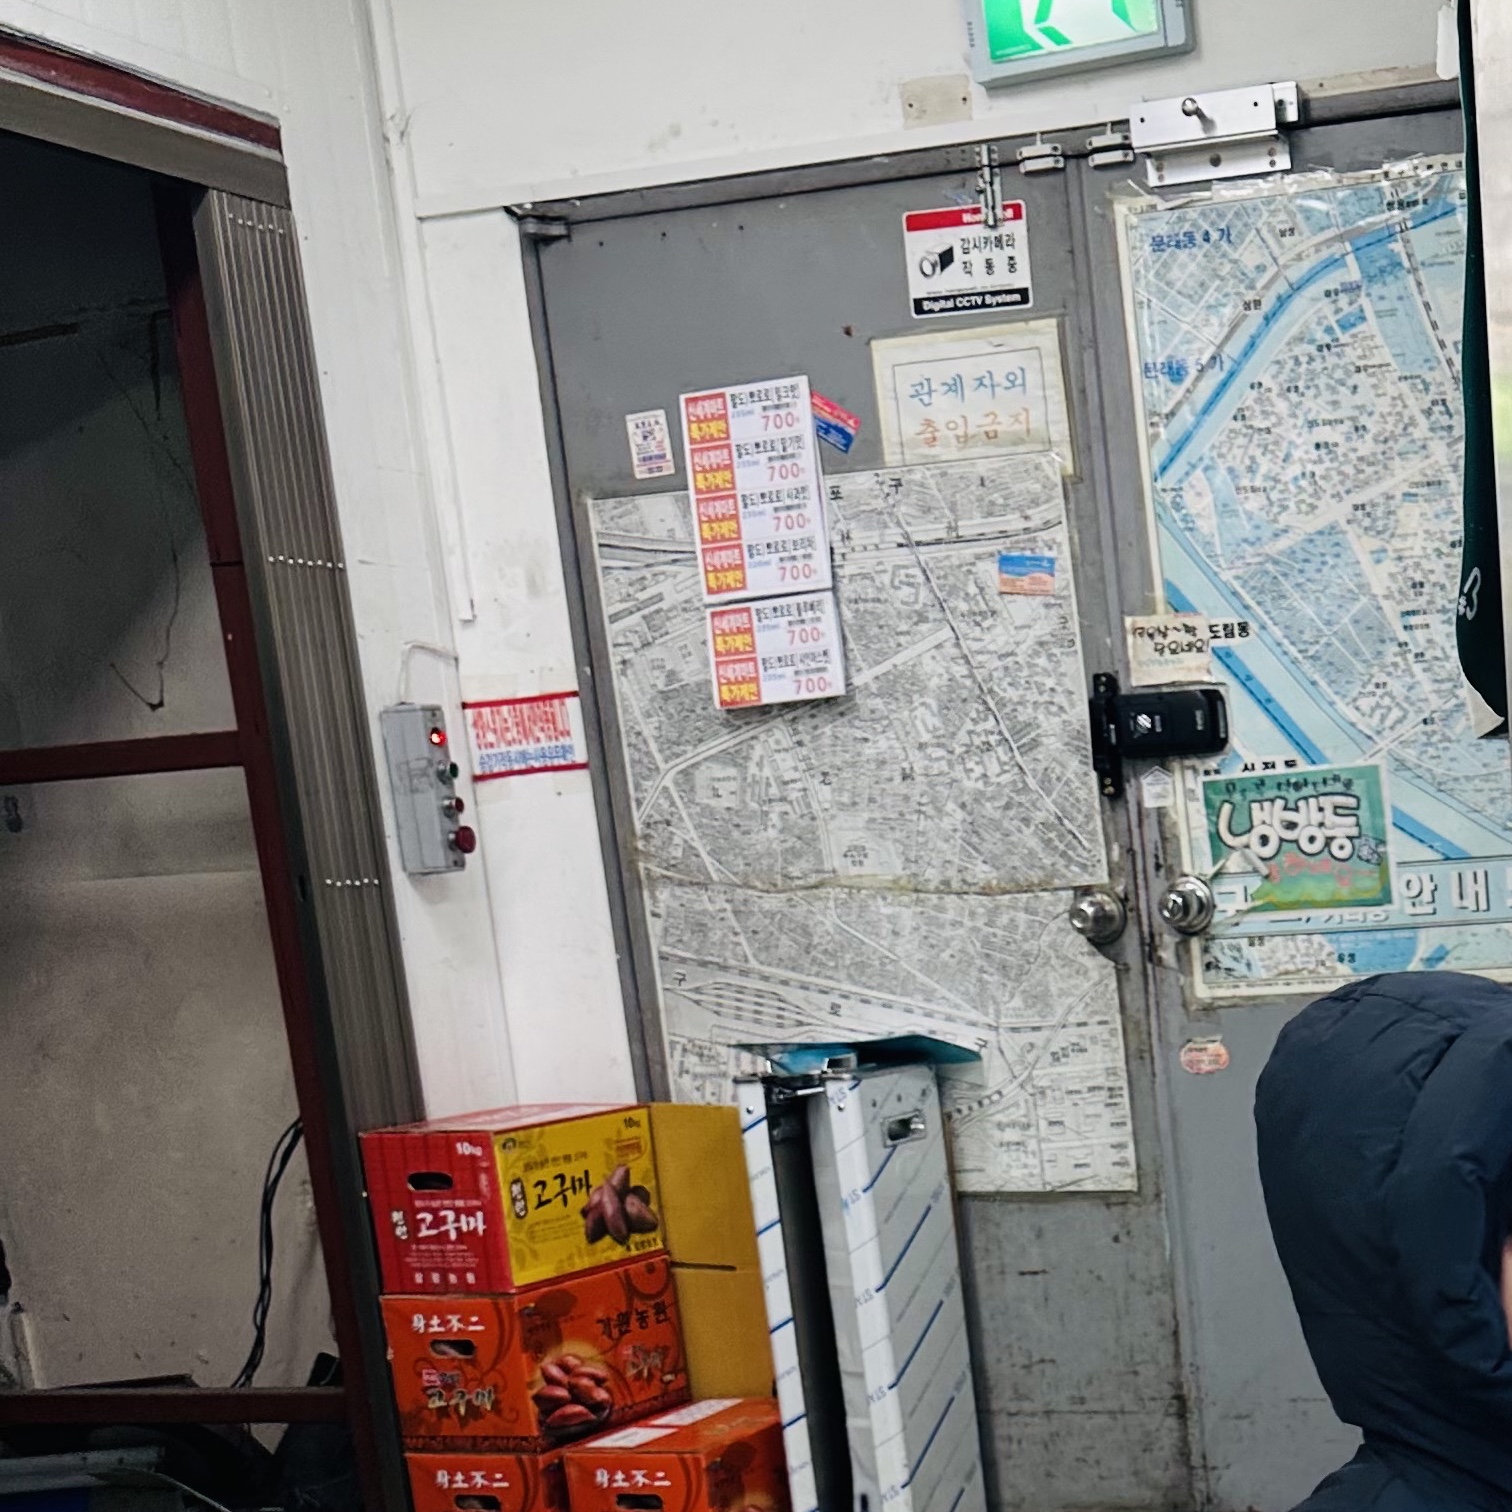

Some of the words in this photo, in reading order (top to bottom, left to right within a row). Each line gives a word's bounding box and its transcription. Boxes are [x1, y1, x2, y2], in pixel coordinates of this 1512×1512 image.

[922, 298, 954, 312] Digital
[956, 295, 983, 308] CCTV
[908, 366, 1028, 407] 관계자외
[915, 406, 1031, 450] 출입금지
[533, 1169, 593, 1210] 고구마
[415, 1210, 487, 1241] 고구마
[412, 1314, 485, 1334] 身土不二
[434, 1469, 510, 1489] 身土不二
[594, 1468, 672, 1488] 身土不二
